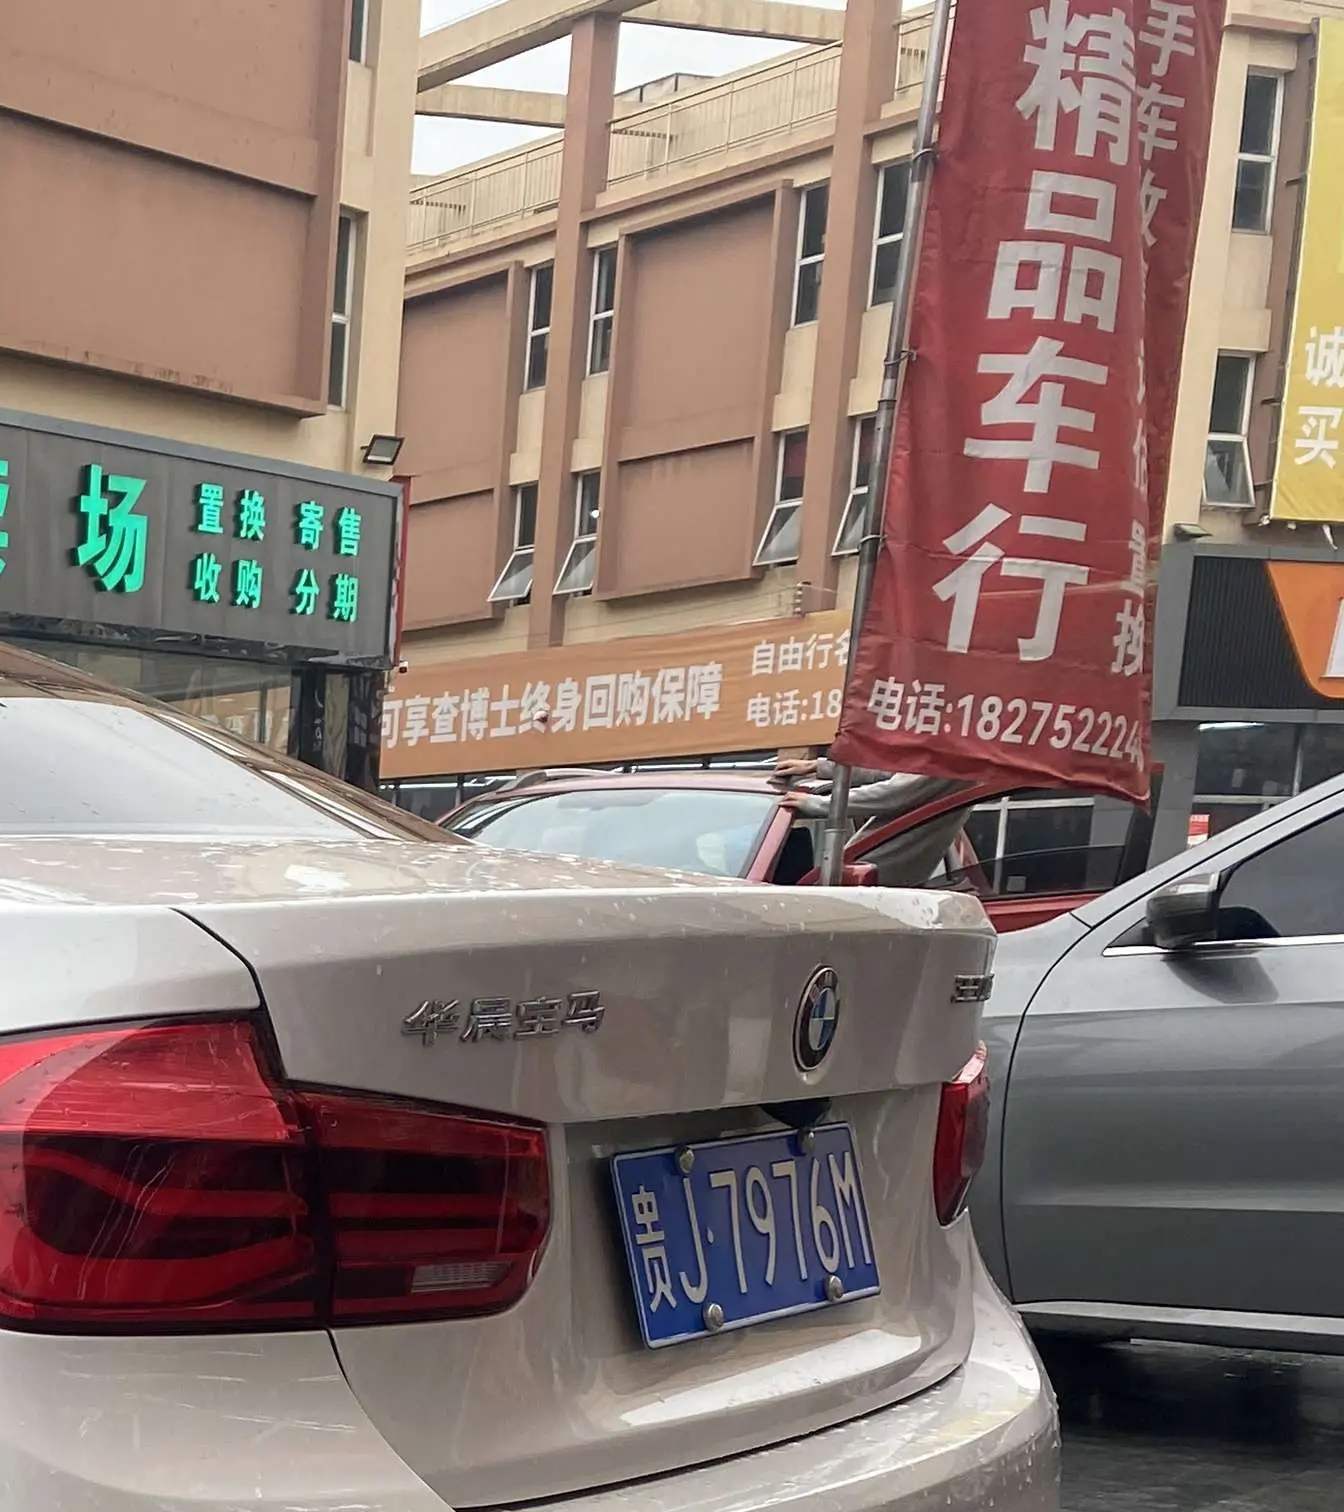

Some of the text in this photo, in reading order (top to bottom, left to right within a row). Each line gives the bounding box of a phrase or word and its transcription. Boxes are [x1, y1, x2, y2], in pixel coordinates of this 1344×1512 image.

[932, 0, 1141, 663] 精品车行
[196, 481, 363, 556] 置换 寄售
[193, 552, 360, 622] 收购 分期
[401, 990, 606, 1047] 华晨宝马
